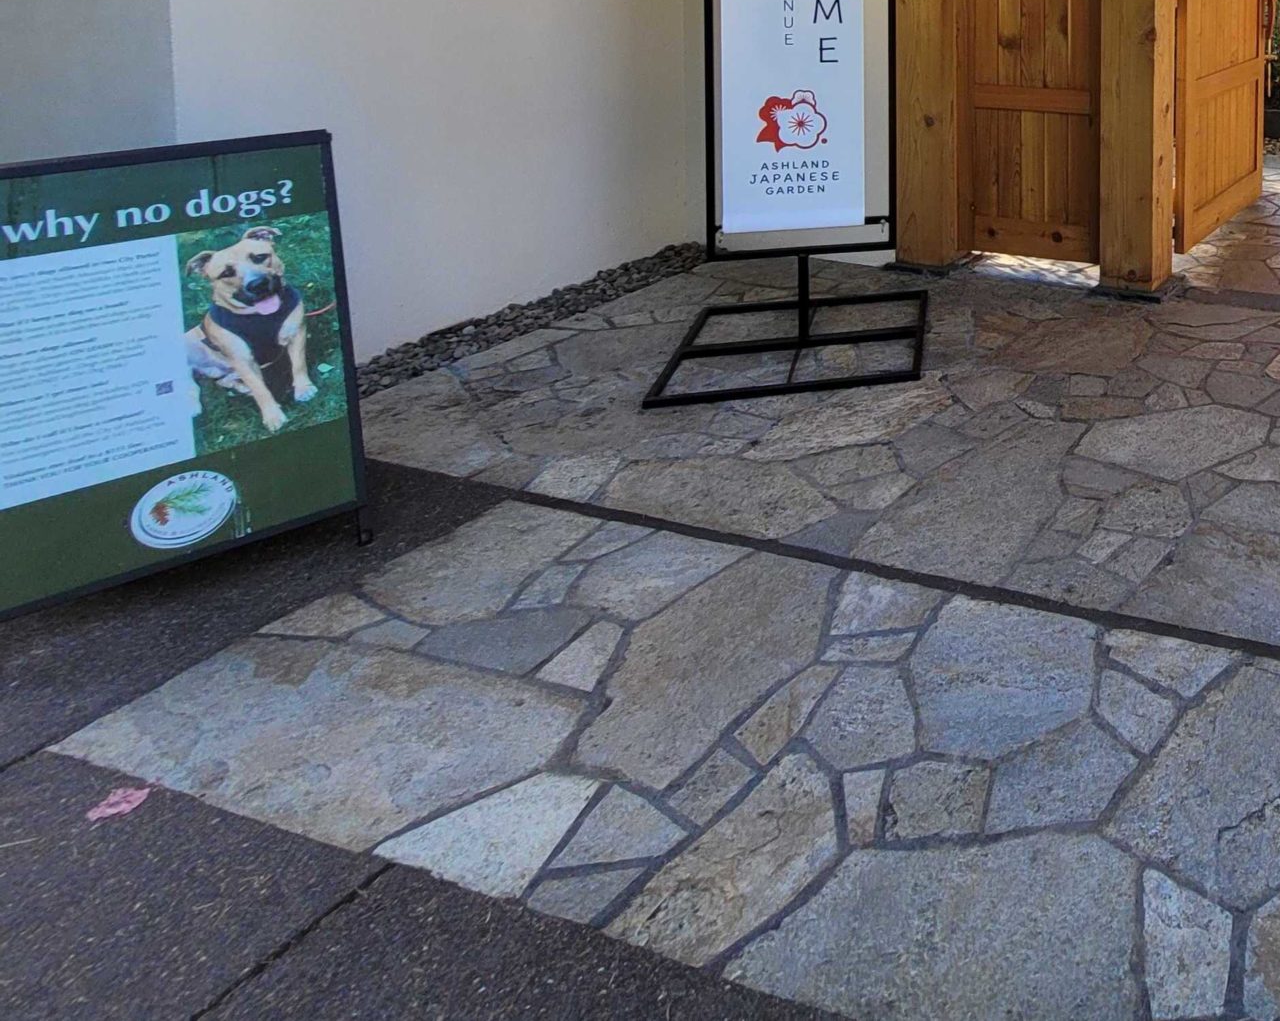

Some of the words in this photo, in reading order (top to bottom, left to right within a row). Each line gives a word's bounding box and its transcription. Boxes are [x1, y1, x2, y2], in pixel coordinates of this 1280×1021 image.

[760, 160, 830, 171] ASHLAND
[749, 171, 840, 184] JAPANESE
[765, 184, 825, 195] GARDEN
[1, 209, 100, 243] why
[116, 203, 171, 228] no
[185, 179, 294, 218] dogs?
[166, 472, 234, 493] ASHLAND
